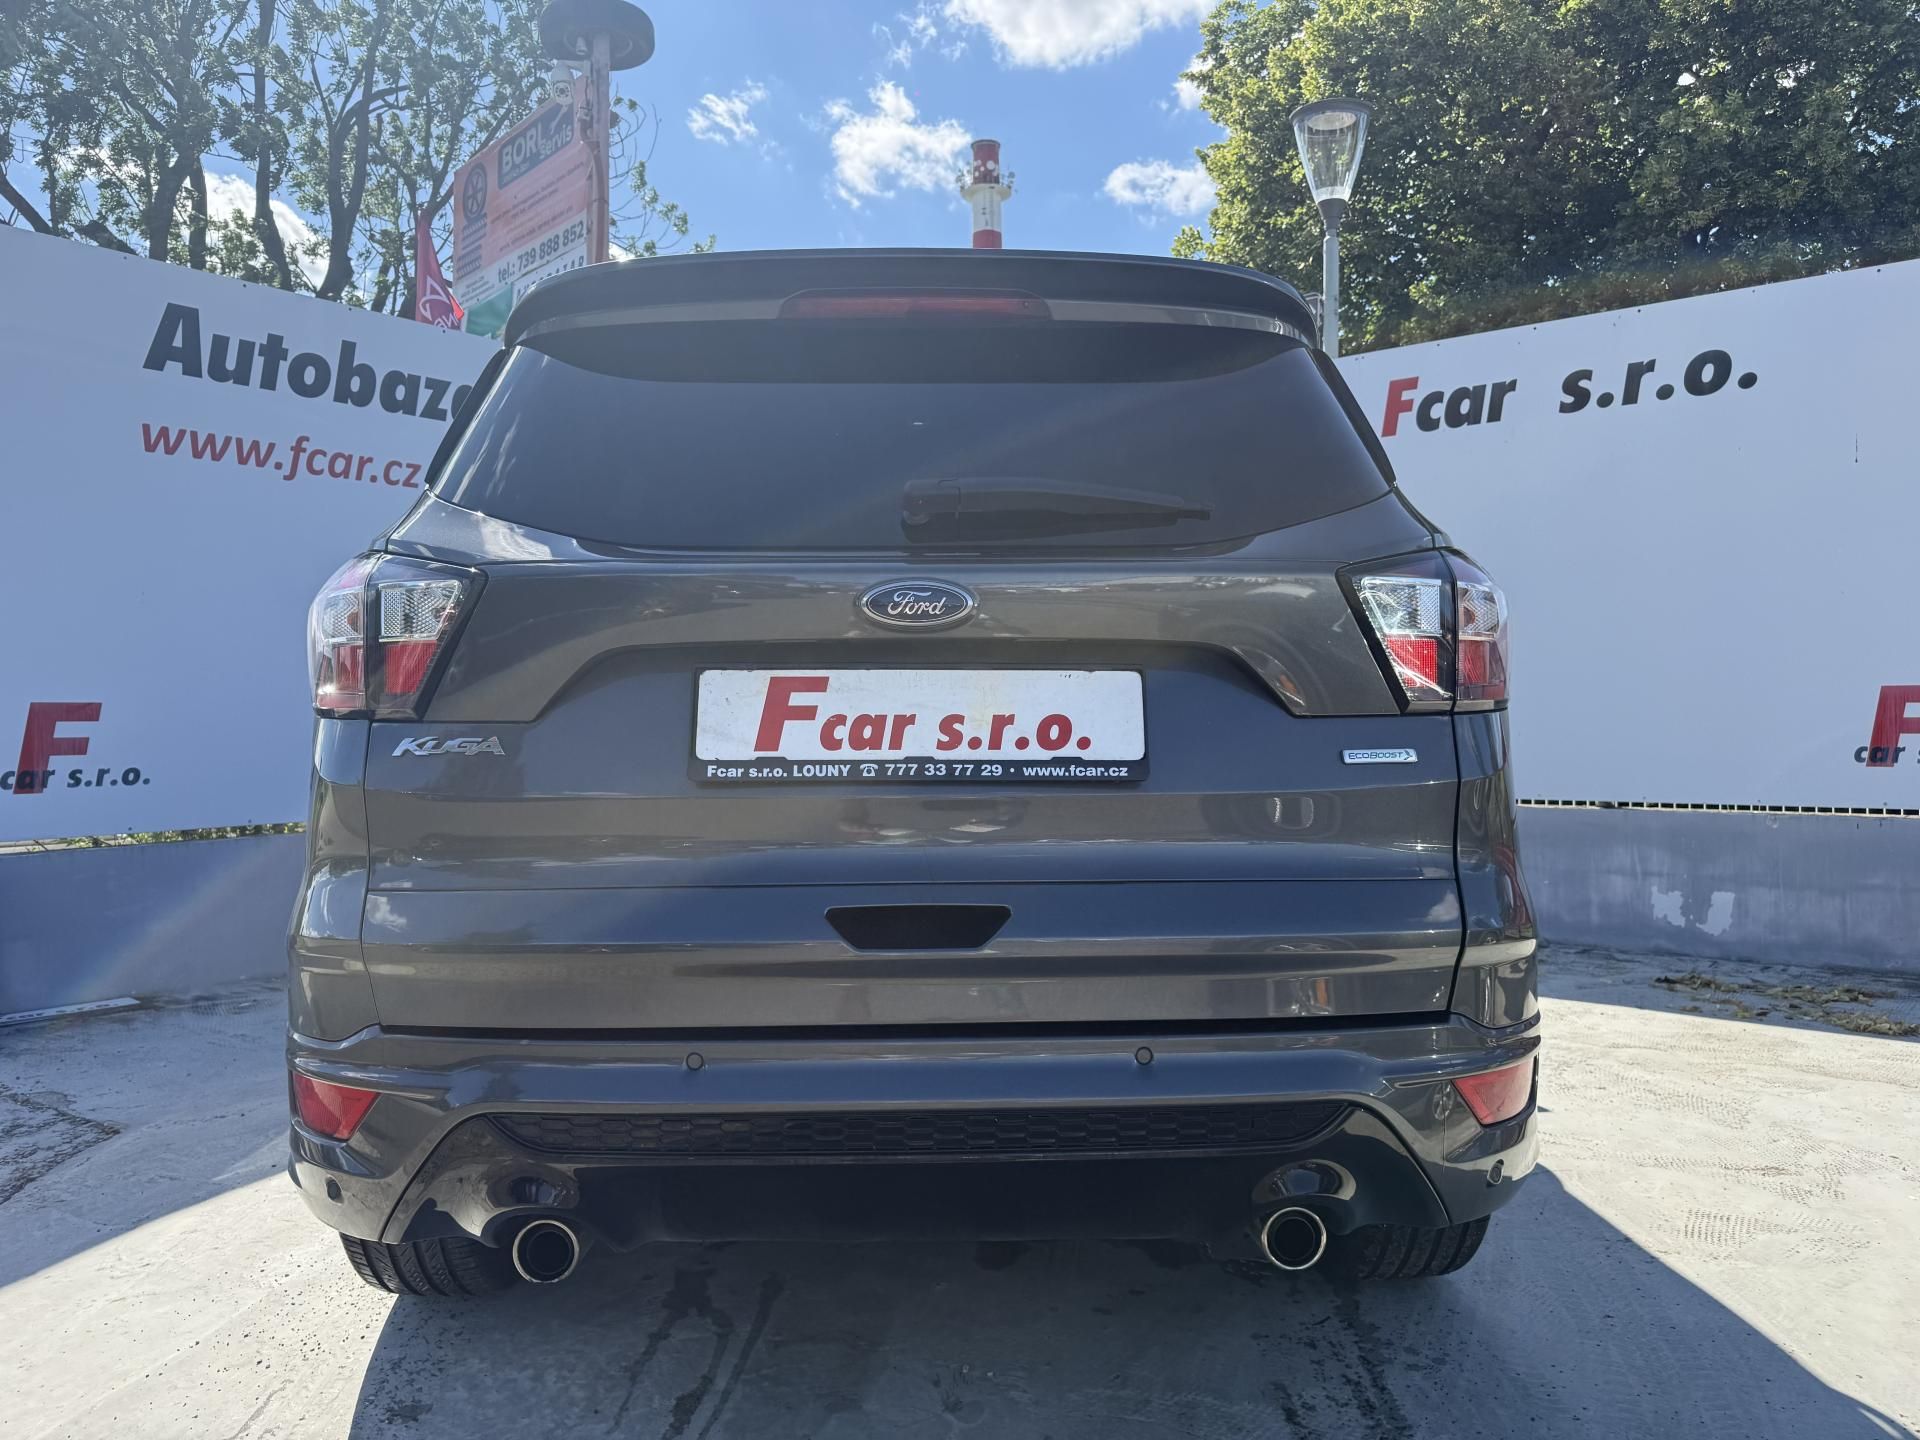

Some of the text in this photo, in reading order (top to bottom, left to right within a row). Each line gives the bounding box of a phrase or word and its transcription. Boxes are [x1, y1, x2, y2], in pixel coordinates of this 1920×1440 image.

[517, 247, 537, 272] 739
[539, 233, 560, 260] 888
[562, 220, 585, 247] 852
[1381, 349, 1758, 437] Fcar s.r.o.
[141, 422, 422, 489] www.fcar.cz
[887, 590, 946, 615] Ford
[935, 713, 1092, 752] s.r.o.
[391, 736, 505, 756] KUGA
[1348, 751, 1404, 760] ECOBOOST
[66, 767, 151, 788] s.r.o.
[707, 763, 1128, 778] Fcar s.r.o. LOUNY 777 33 77 29 www.fcar.cz
